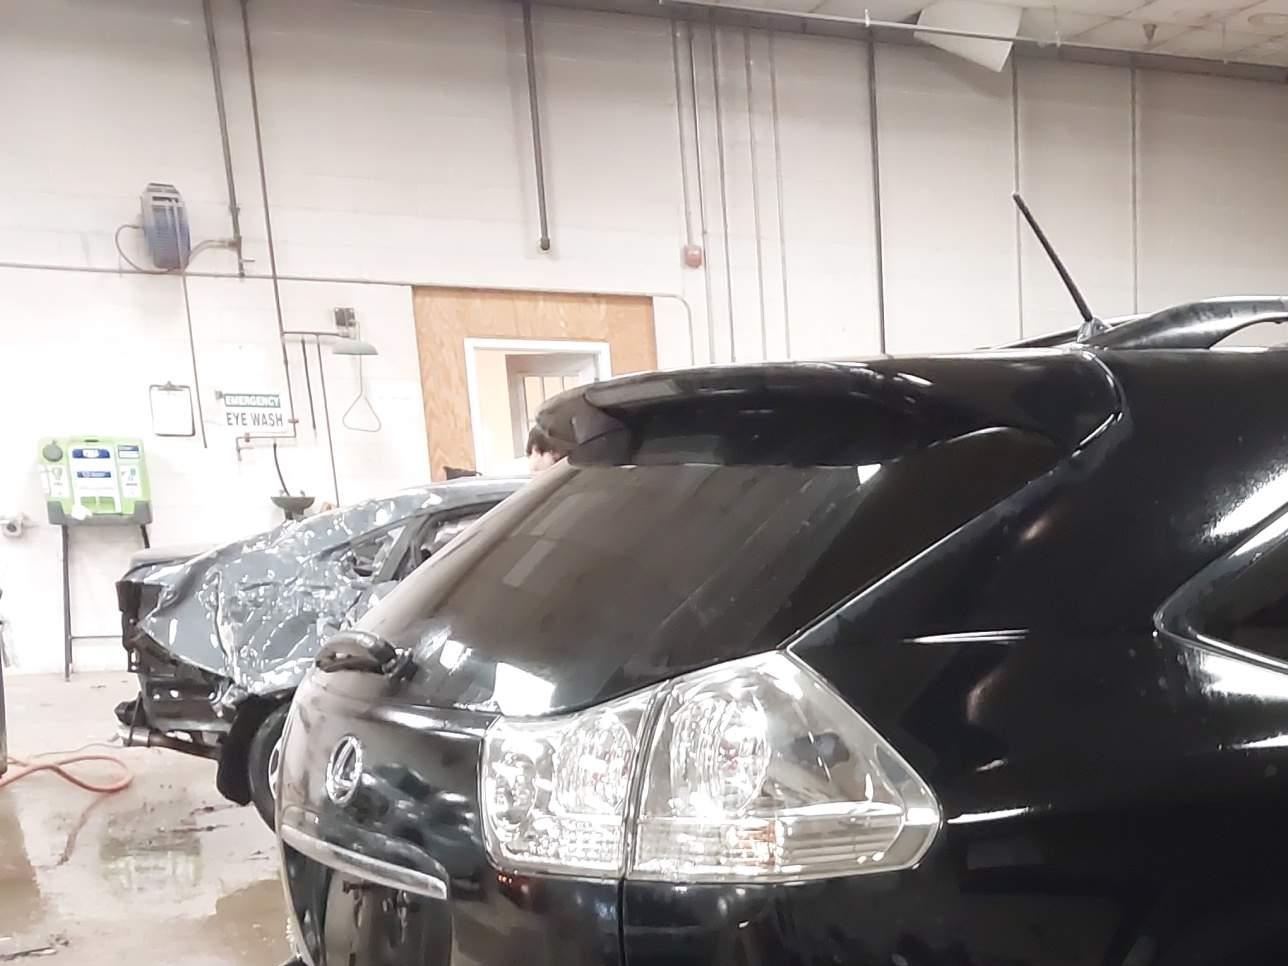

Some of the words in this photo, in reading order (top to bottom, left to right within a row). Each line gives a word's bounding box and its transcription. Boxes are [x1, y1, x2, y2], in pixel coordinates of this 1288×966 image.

[224, 394, 280, 407] EMERGENCY
[226, 412, 248, 426] EYE
[250, 412, 284, 427] WASH
